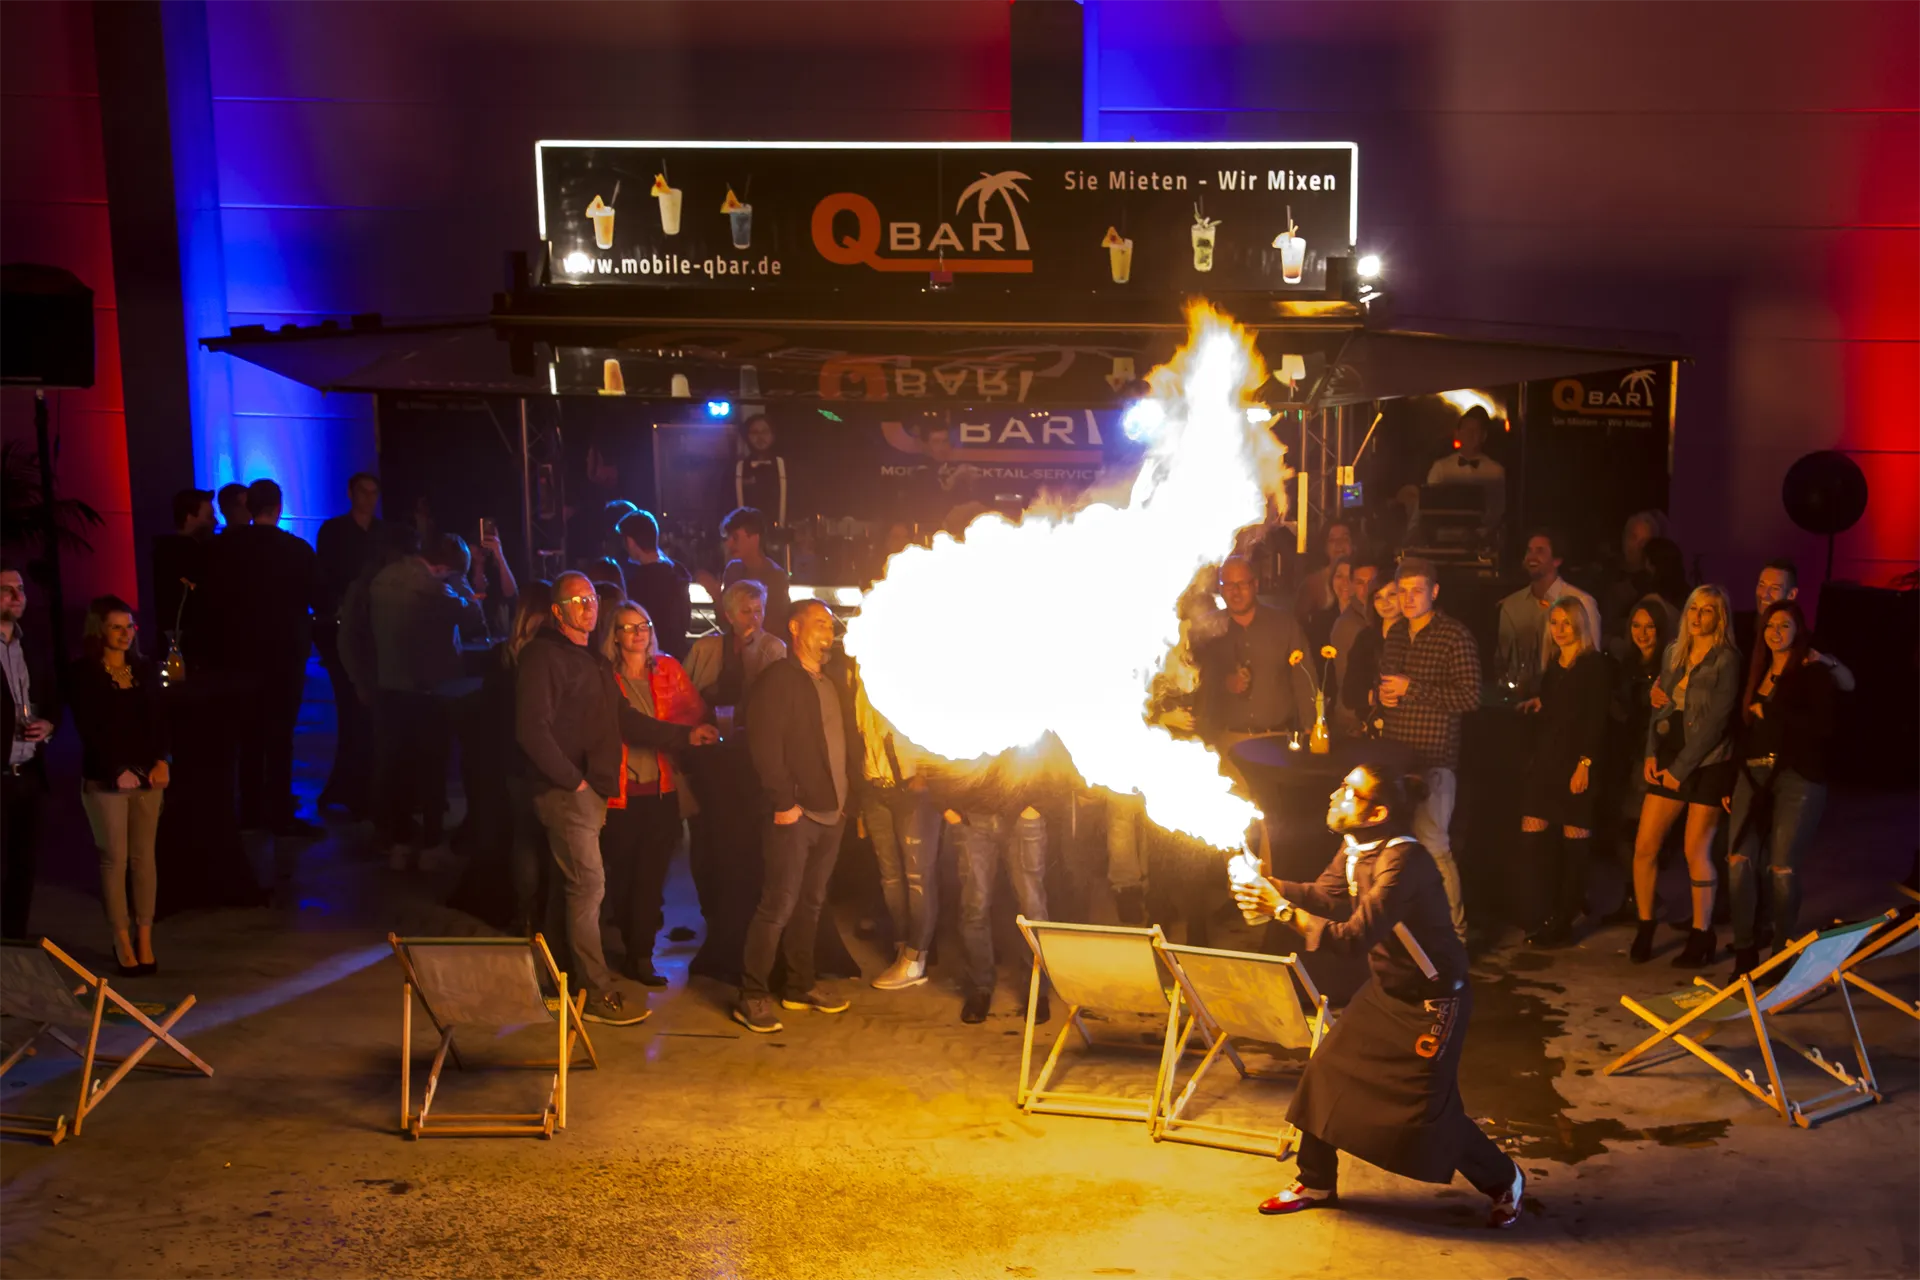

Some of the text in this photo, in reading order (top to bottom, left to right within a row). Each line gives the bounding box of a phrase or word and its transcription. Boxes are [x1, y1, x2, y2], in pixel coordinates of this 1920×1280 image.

[1063, 170, 1099, 191] Sie
[1108, 170, 1188, 191] Mieten
[1217, 170, 1258, 191] Wir
[1267, 170, 1337, 191] Mixen
